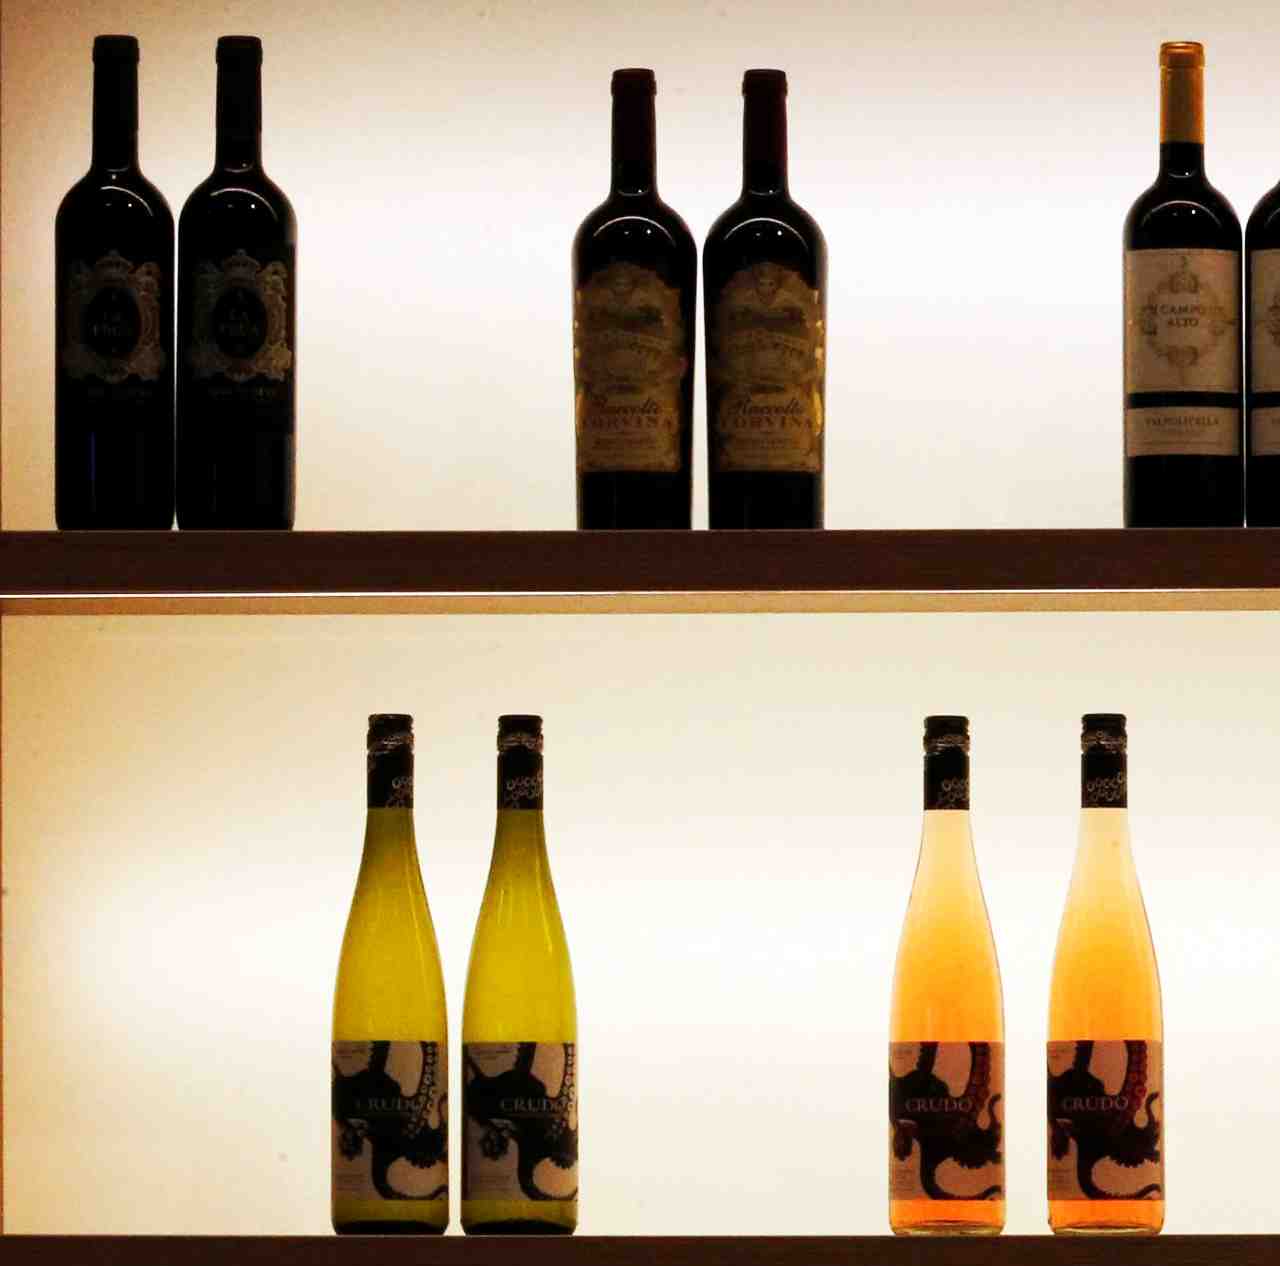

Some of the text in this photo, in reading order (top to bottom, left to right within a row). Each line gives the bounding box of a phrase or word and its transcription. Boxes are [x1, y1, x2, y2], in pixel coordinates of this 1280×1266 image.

[1159, 303, 1206, 316] CAMPO
[1168, 317, 1199, 329] ALTO
[905, 1097, 974, 1113] CRUDO
[1061, 1096, 1129, 1112] CRUDO
